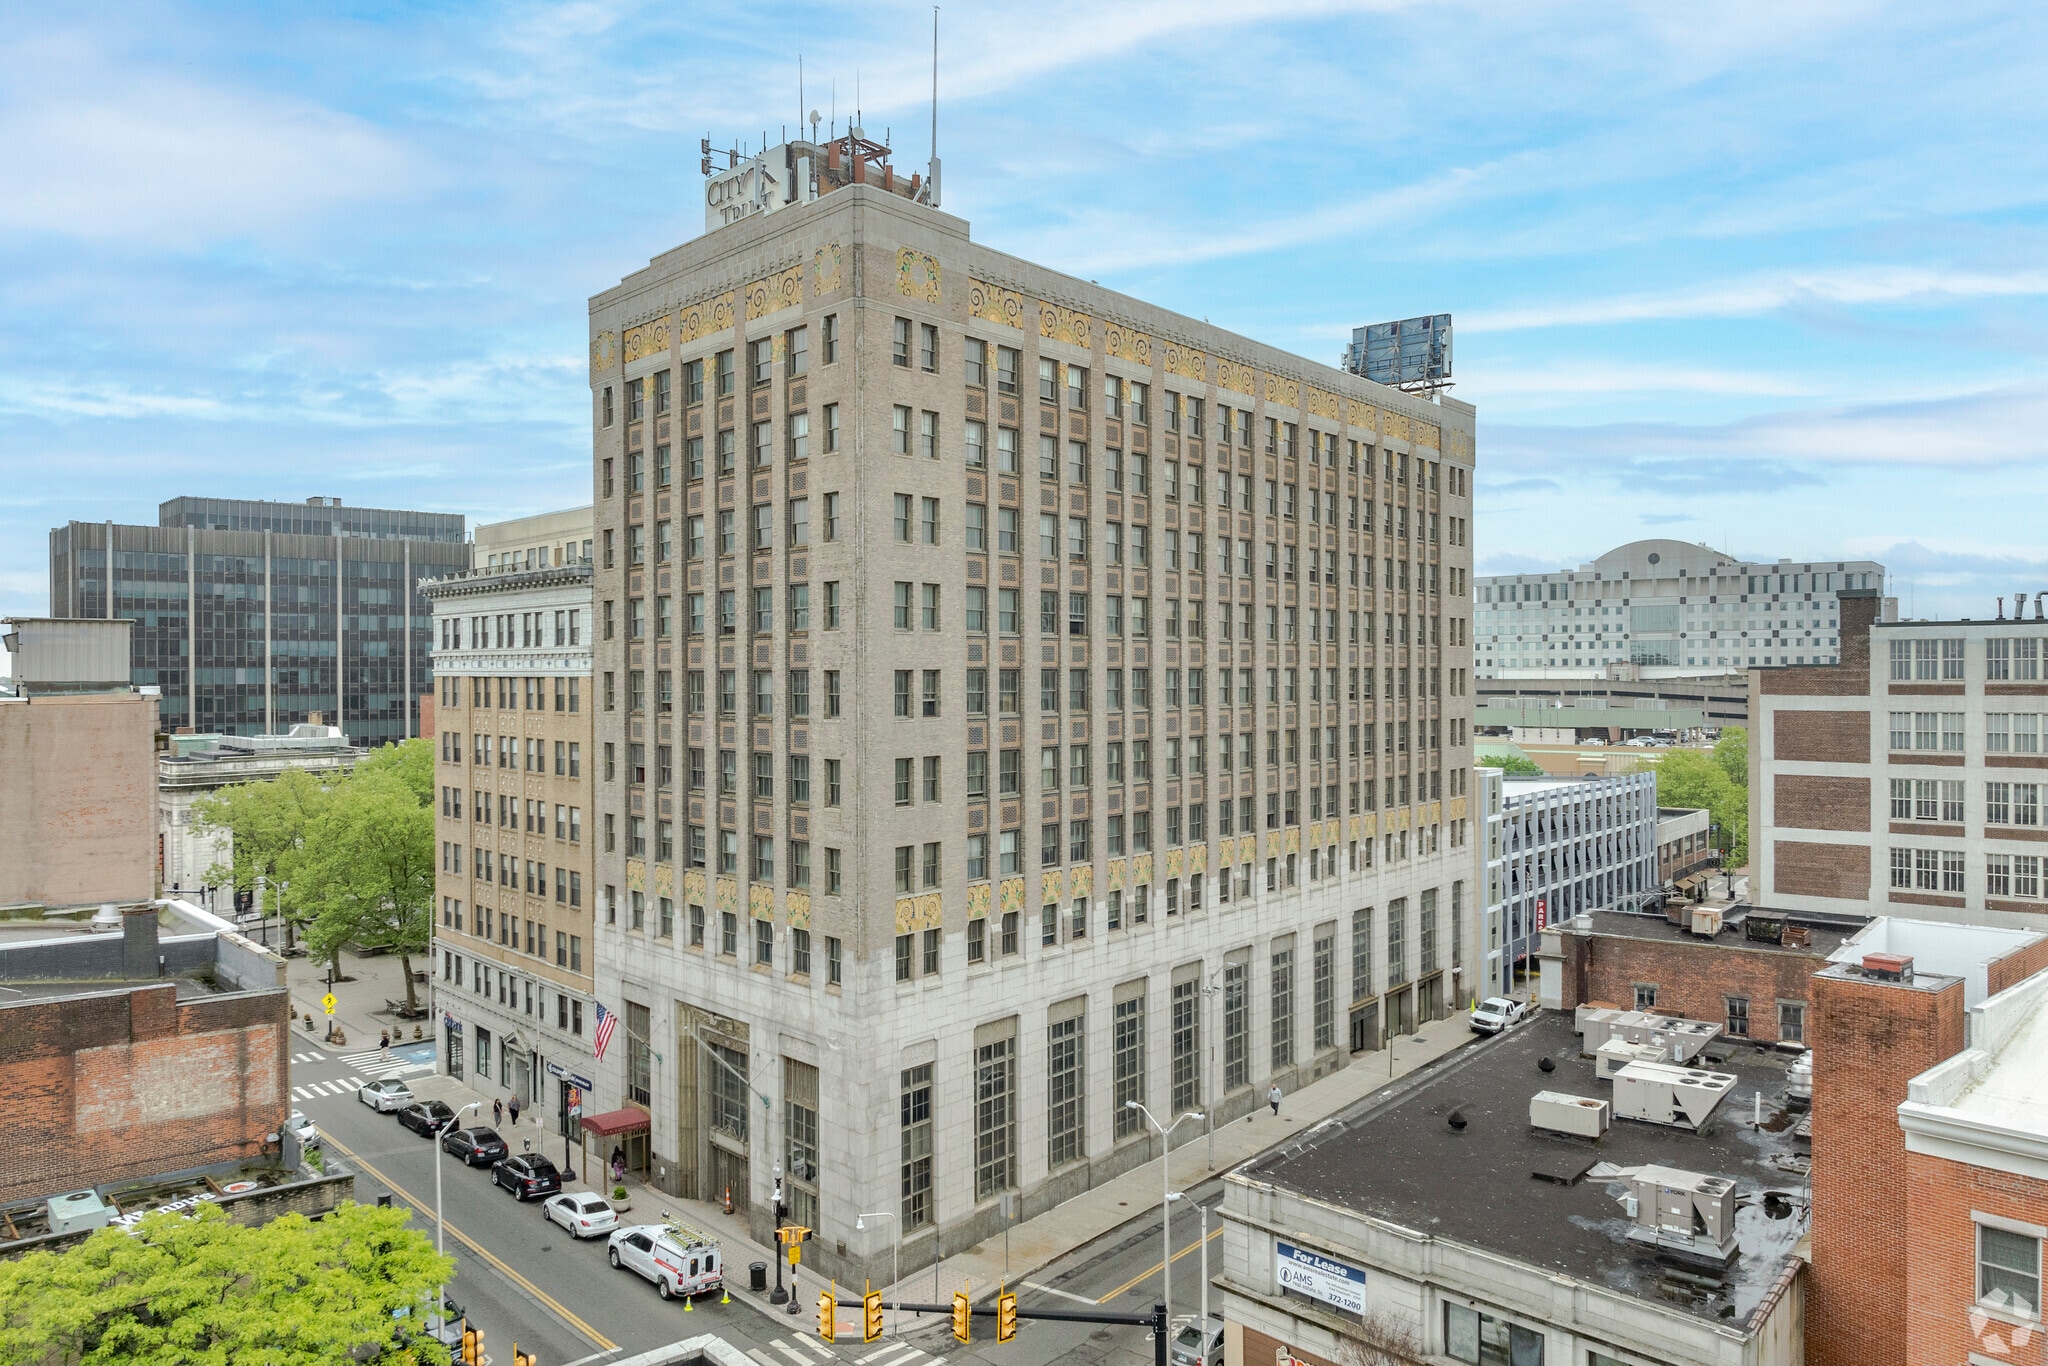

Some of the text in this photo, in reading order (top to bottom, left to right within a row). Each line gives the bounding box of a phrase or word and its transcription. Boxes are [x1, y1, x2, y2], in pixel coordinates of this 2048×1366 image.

[708, 172, 745, 207] CITY
[1288, 1260, 1350, 1286] www.amsrealestate.com
[1293, 1249, 1348, 1276] For Lease
[1292, 1281, 1302, 1289] real
[1293, 1271, 1313, 1286] AMS
[1328, 1292, 1361, 1311] 372-1200
